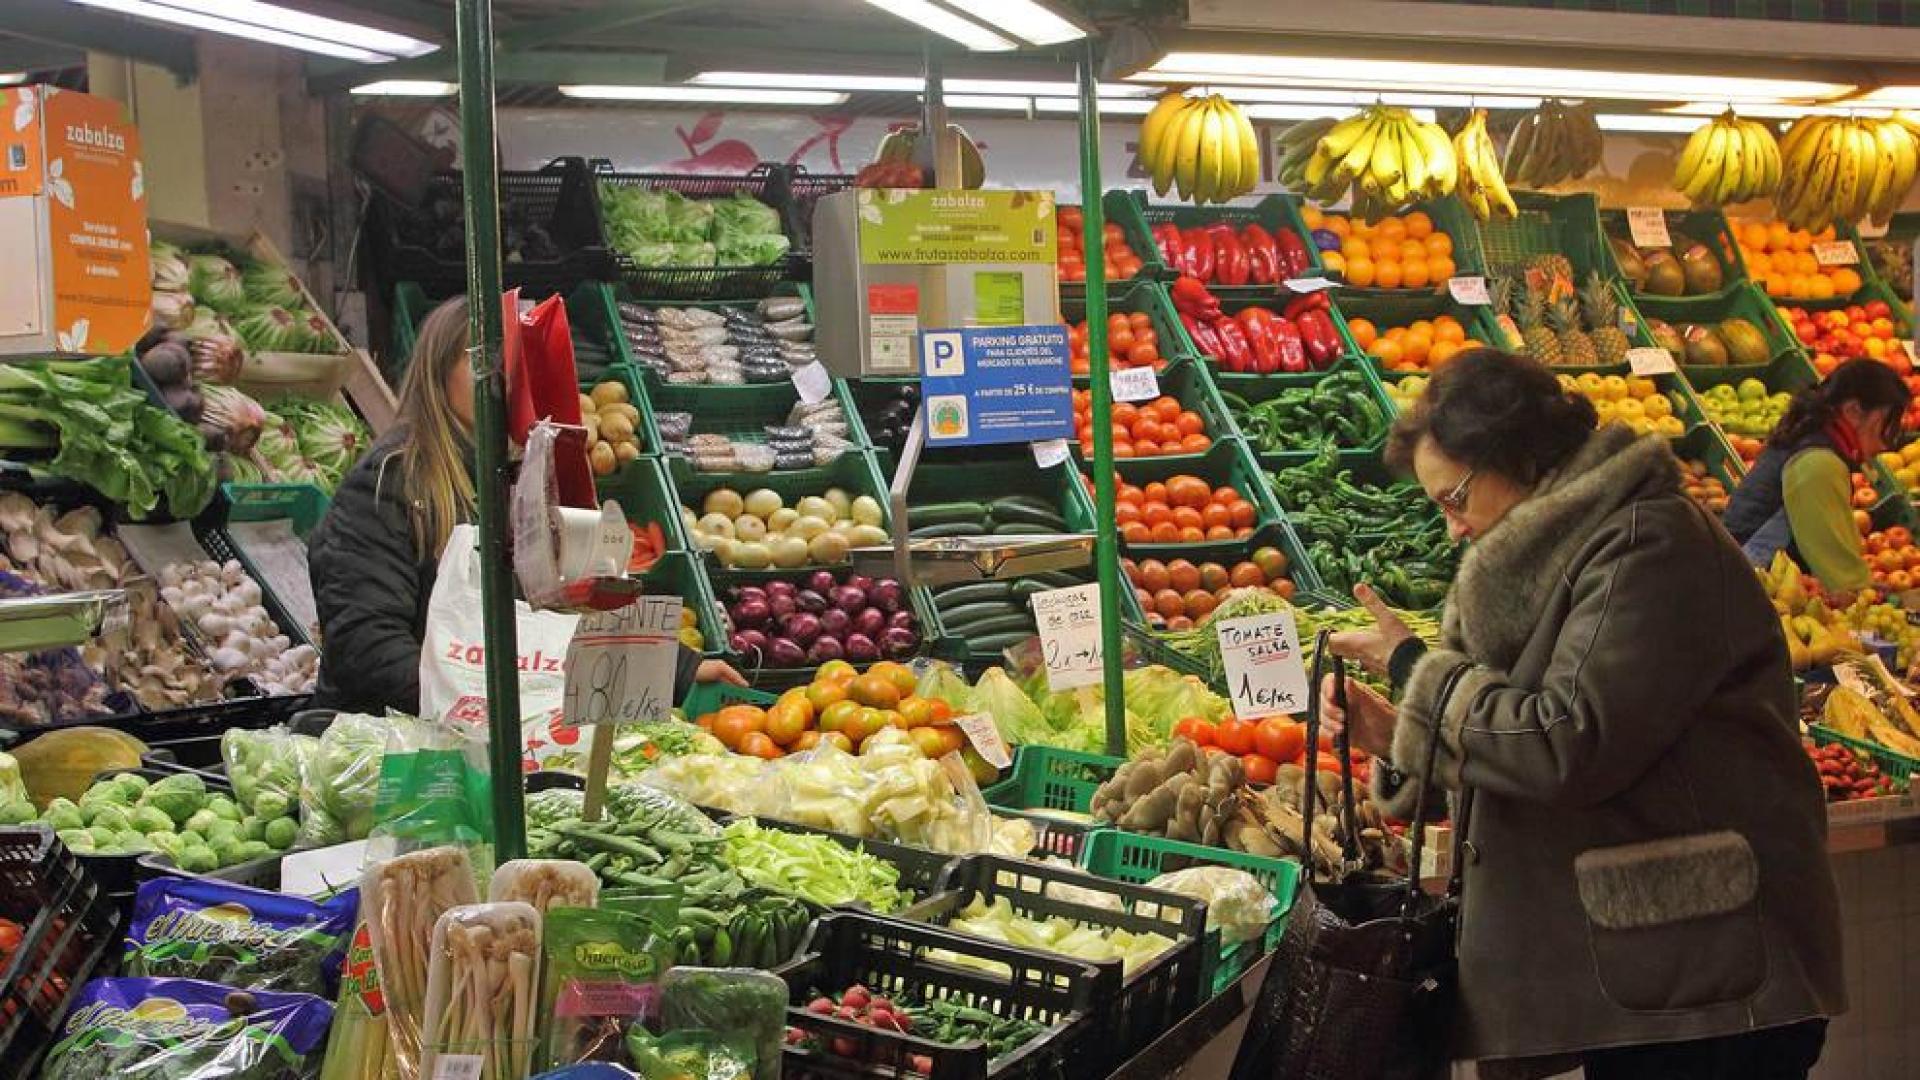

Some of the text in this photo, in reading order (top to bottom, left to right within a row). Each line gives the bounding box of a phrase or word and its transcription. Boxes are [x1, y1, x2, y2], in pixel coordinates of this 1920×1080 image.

[66, 122, 125, 152] zabalza
[931, 192, 986, 208] zabalza
[878, 248, 1041, 261] www.frutaszabalza.com
[973, 333, 1064, 347] PARKING GRATUITO
[934, 340, 954, 368] P
[1006, 347, 1039, 356] CLIENTES
[977, 358, 1011, 368] MERCADO
[1014, 384, 1025, 396] 25
[1027, 383, 1035, 395] €
[1221, 624, 1284, 645] TOMATE
